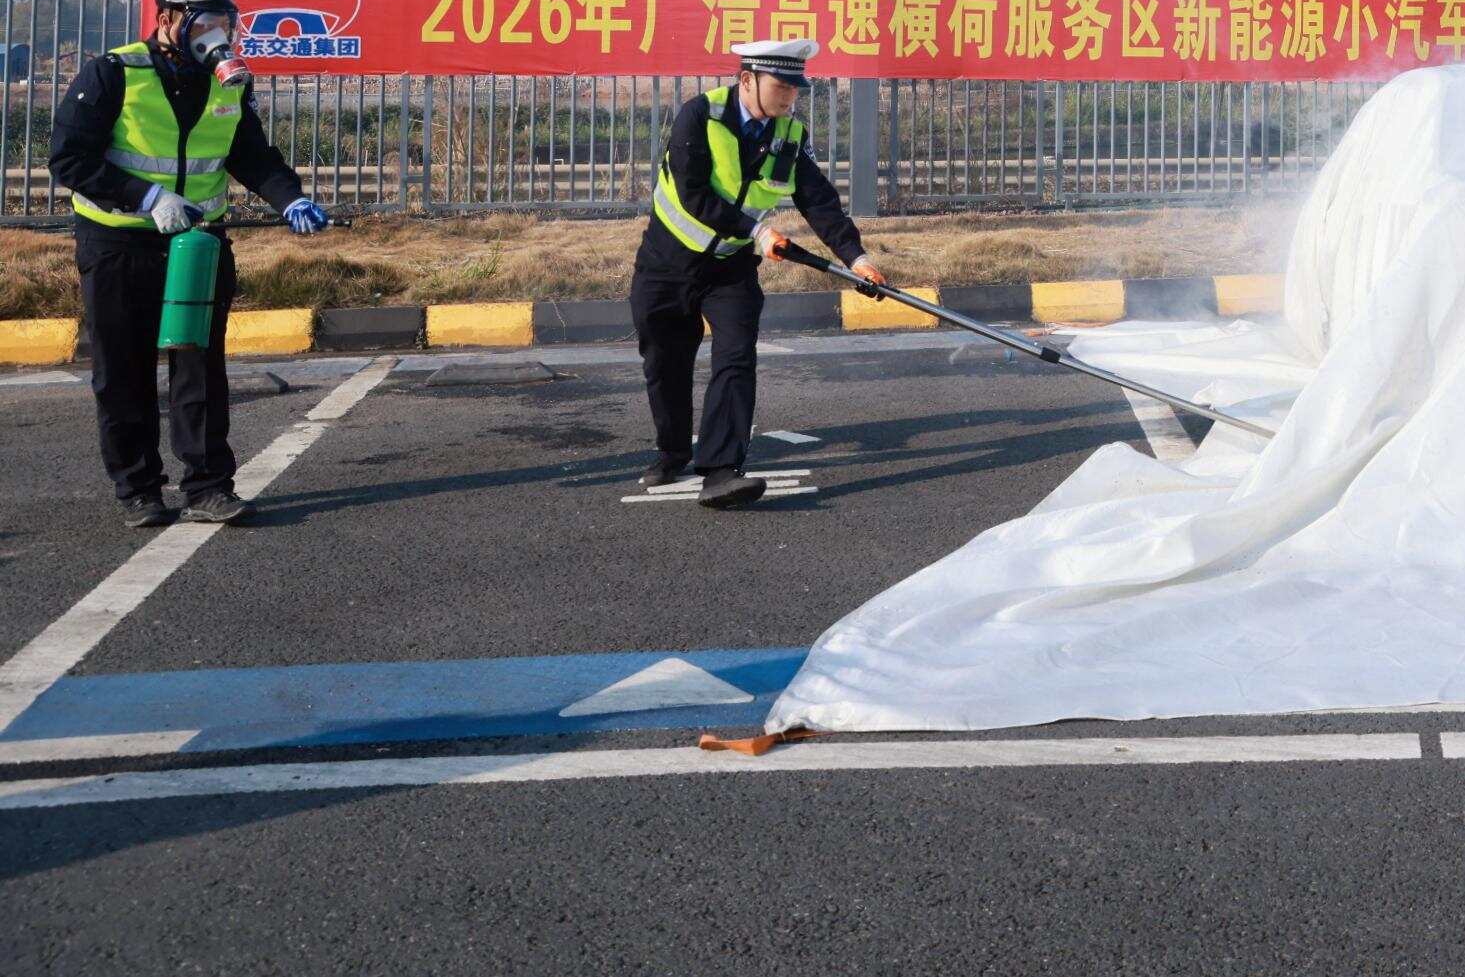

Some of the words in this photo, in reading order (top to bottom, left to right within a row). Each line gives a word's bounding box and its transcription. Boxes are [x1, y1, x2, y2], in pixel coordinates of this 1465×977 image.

[241, 36, 360, 58] 东交通集团
